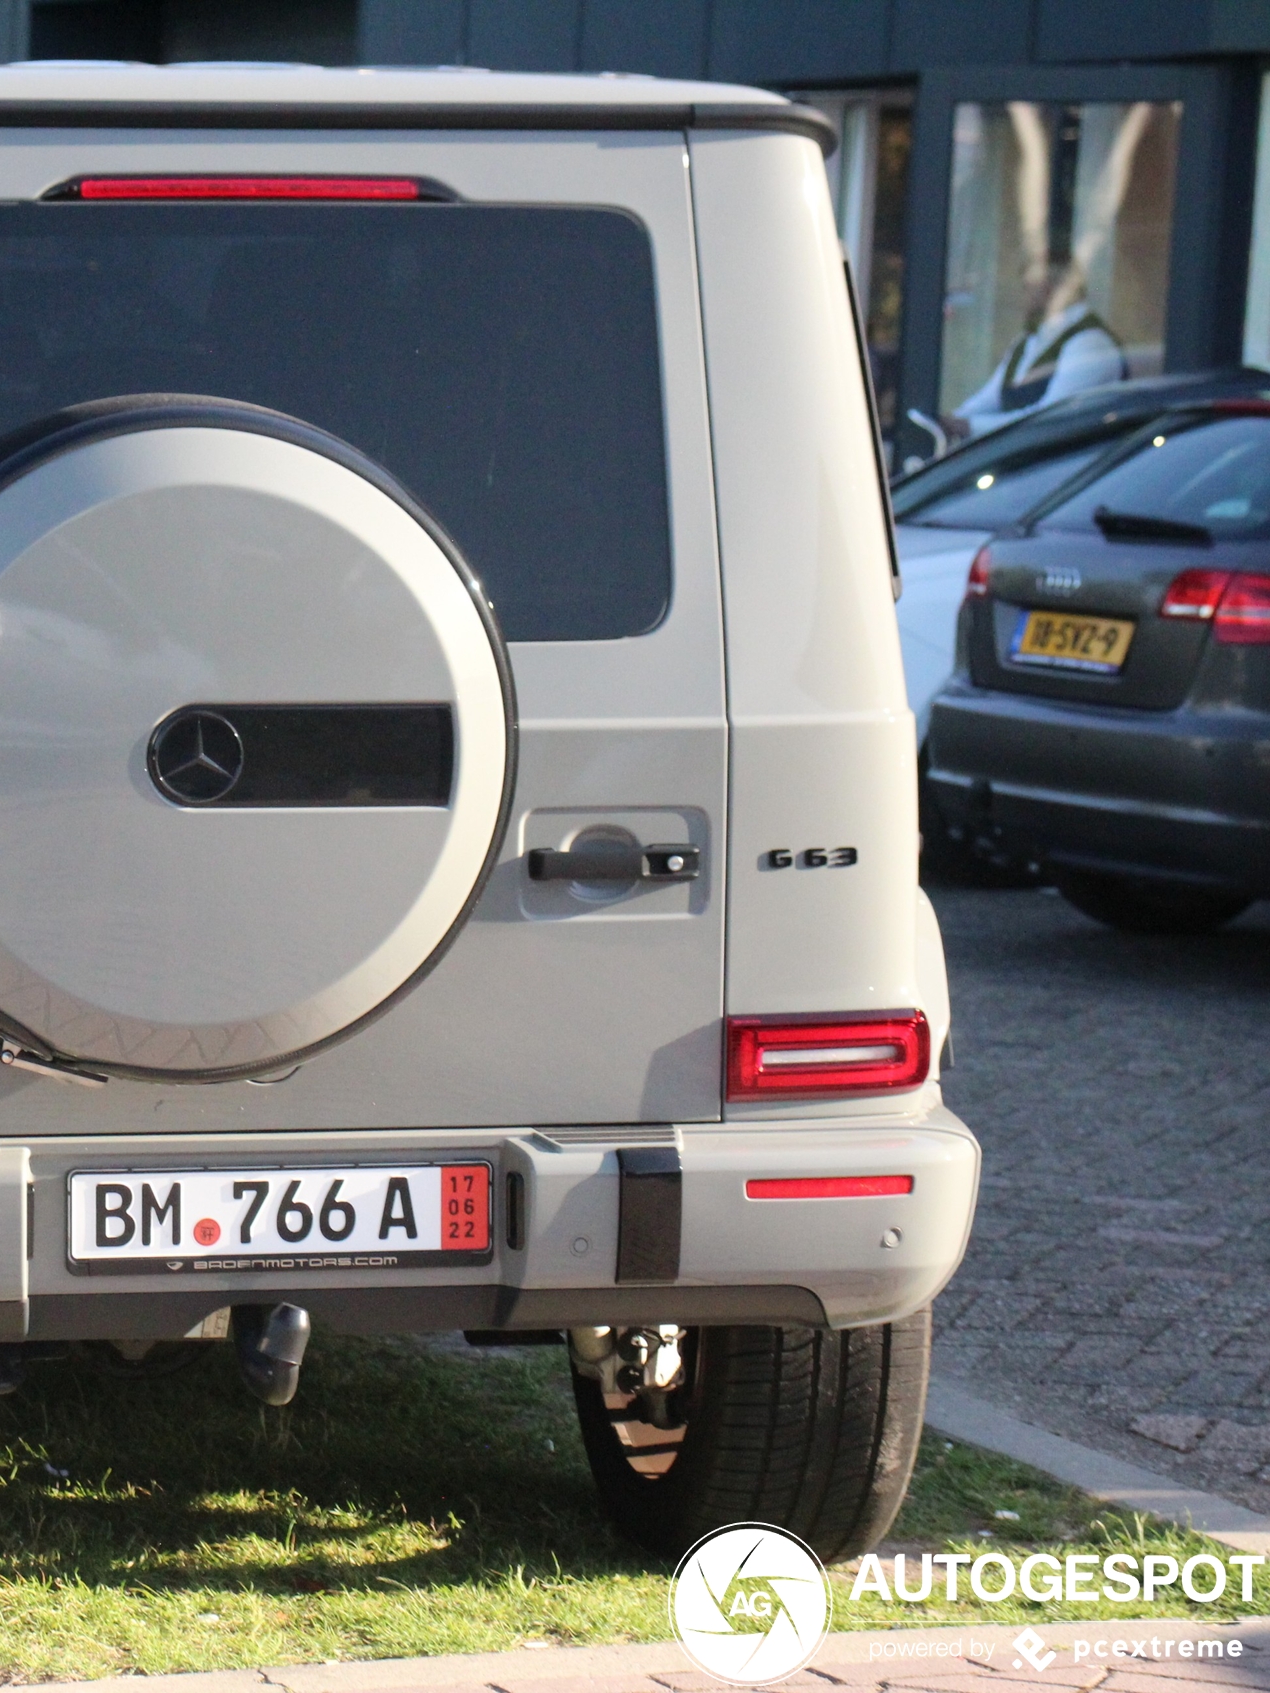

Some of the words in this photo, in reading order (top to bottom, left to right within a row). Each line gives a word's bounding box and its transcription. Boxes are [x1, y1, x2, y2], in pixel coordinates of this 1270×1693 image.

[448, 1175, 474, 1194] 17
[95, 1181, 182, 1248] BM
[232, 1178, 356, 1244] 766
[378, 1176, 418, 1240] A
[447, 1198, 475, 1216] 06
[448, 1221, 475, 1239] 22
